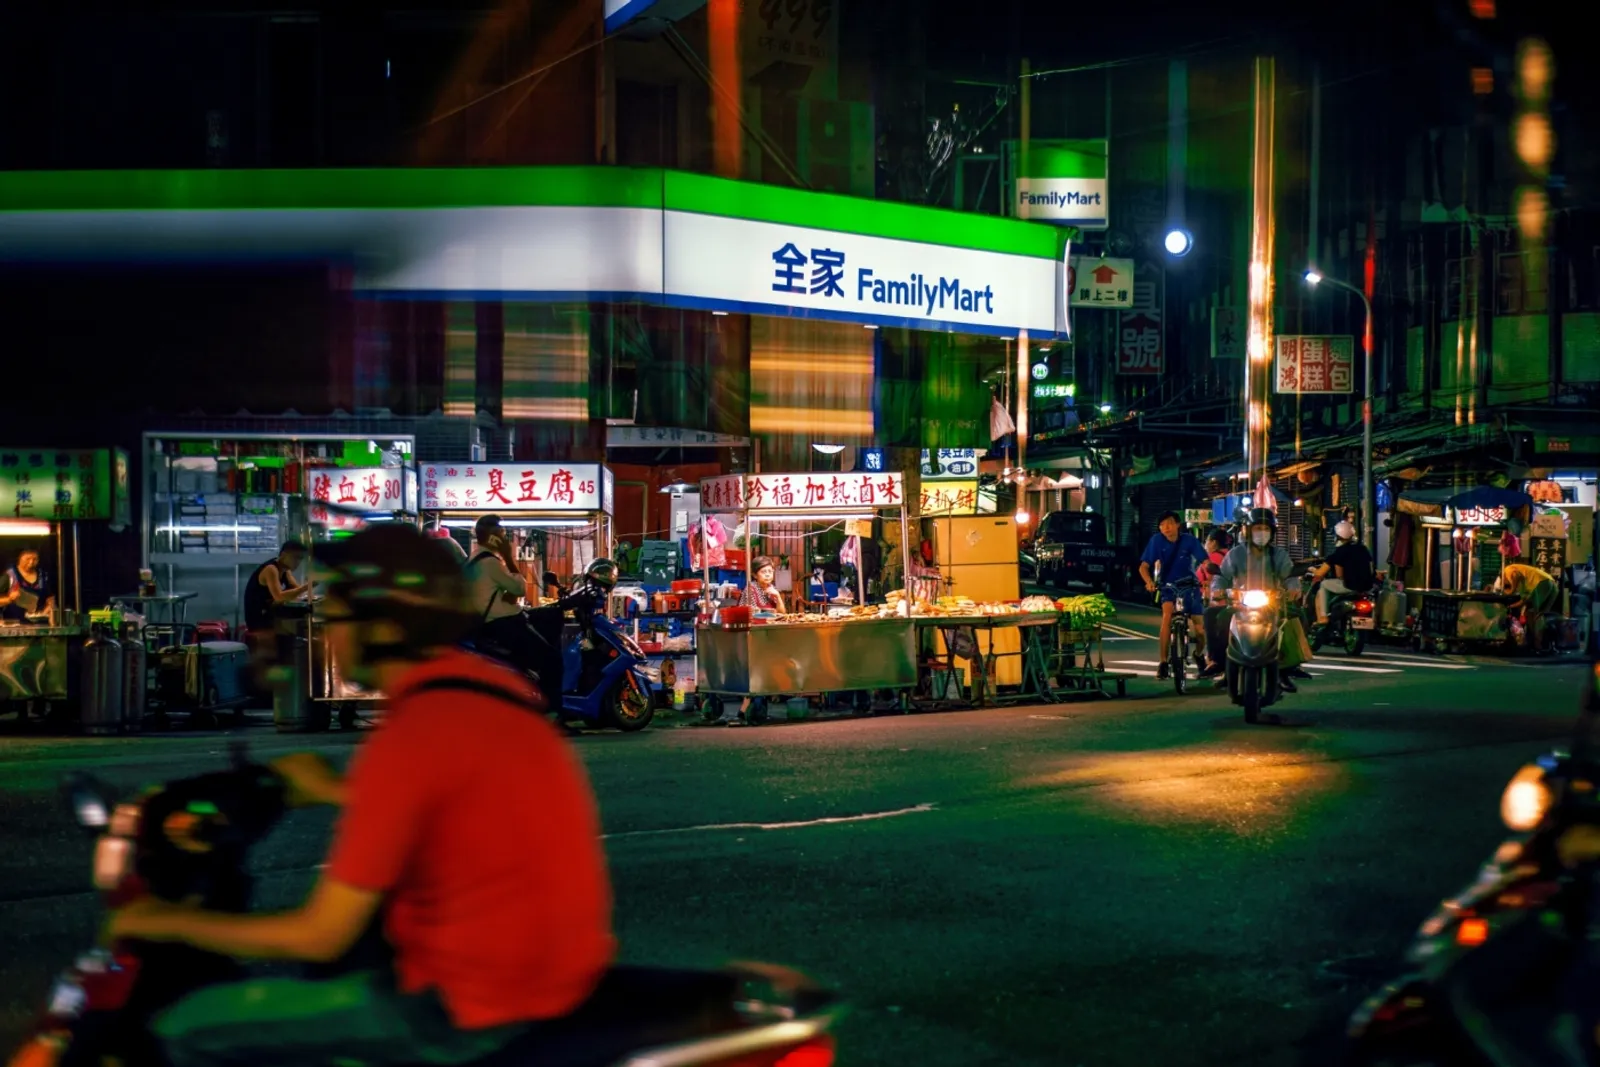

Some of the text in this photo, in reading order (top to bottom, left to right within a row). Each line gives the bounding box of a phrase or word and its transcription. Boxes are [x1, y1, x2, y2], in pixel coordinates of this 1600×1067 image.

[1020, 192, 1101, 208] FamilyMart
[772, 242, 993, 315] 全家 FamilyMart
[384, 479, 401, 501] 30
[484, 468, 573, 505] 臭豆腐
[577, 480, 594, 495] 45
